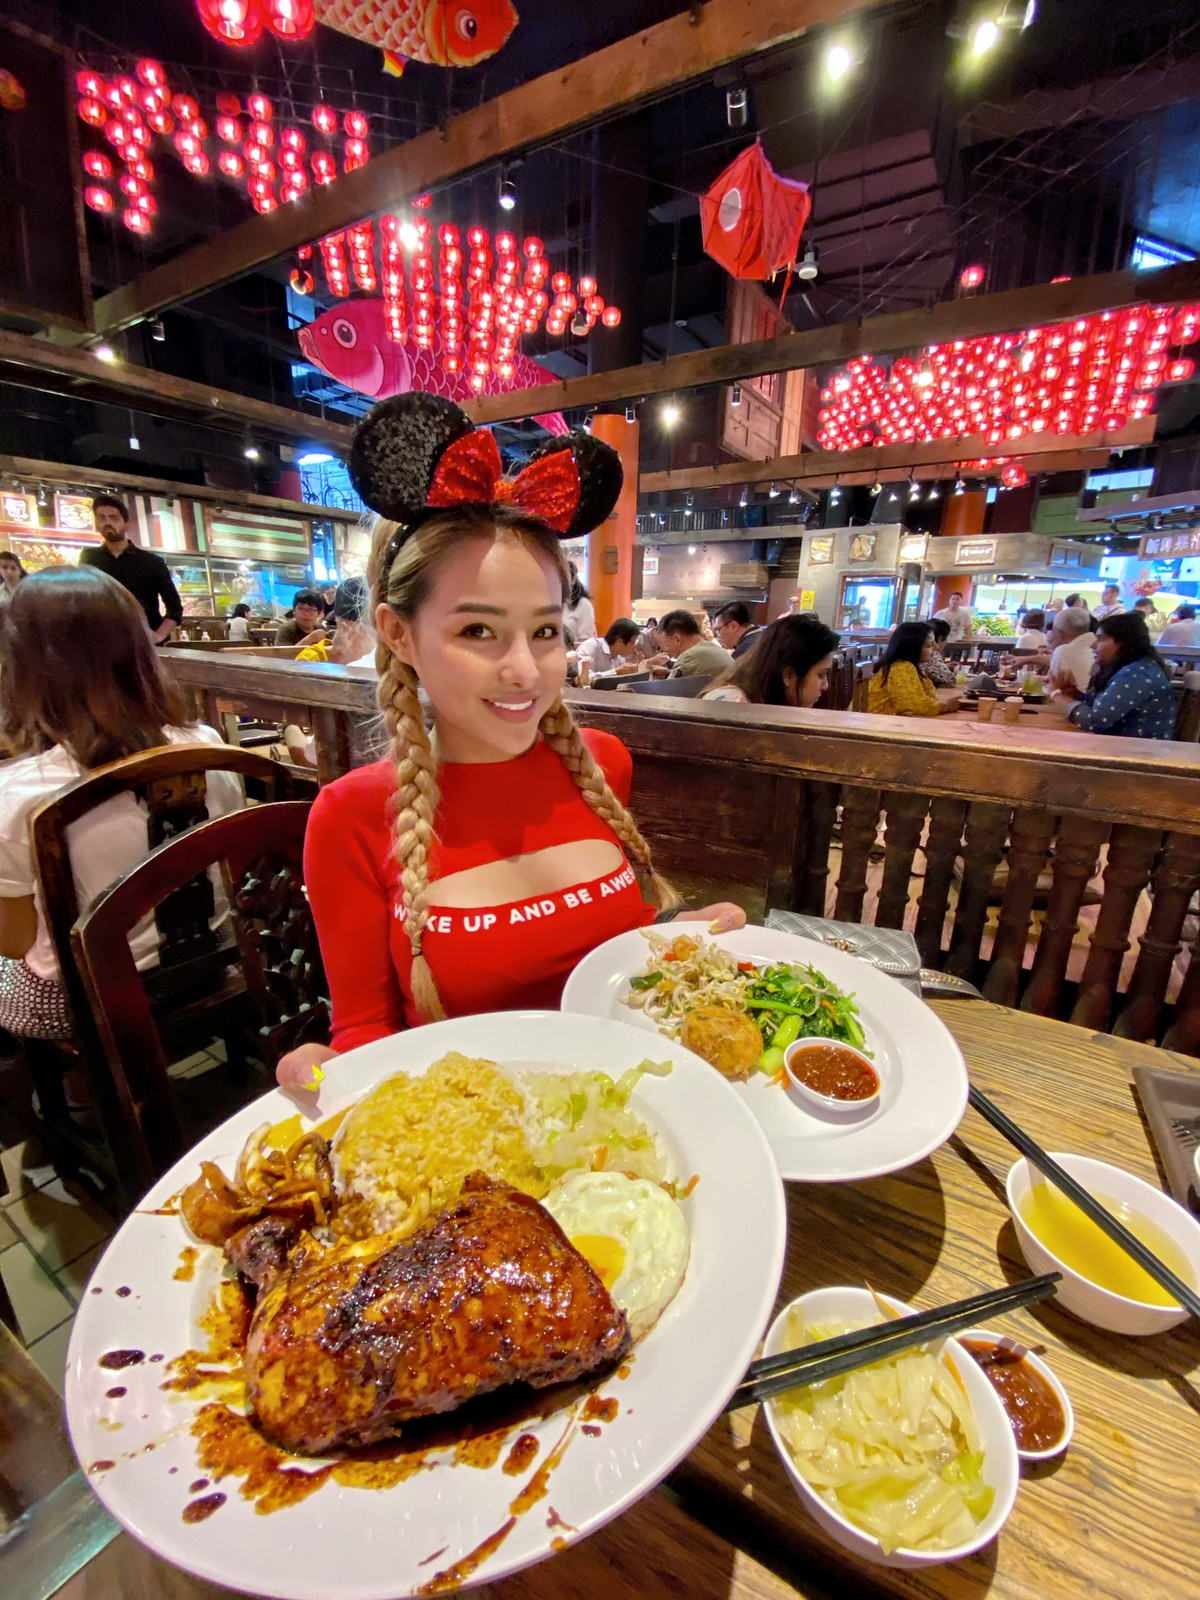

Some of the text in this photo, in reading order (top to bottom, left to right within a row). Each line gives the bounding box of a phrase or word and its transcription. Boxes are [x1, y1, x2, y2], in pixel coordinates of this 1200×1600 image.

[394, 902, 452, 933] WKE
[463, 913, 497, 932] UP
[509, 900, 556, 925] AND
[563, 888, 593, 910] BE
